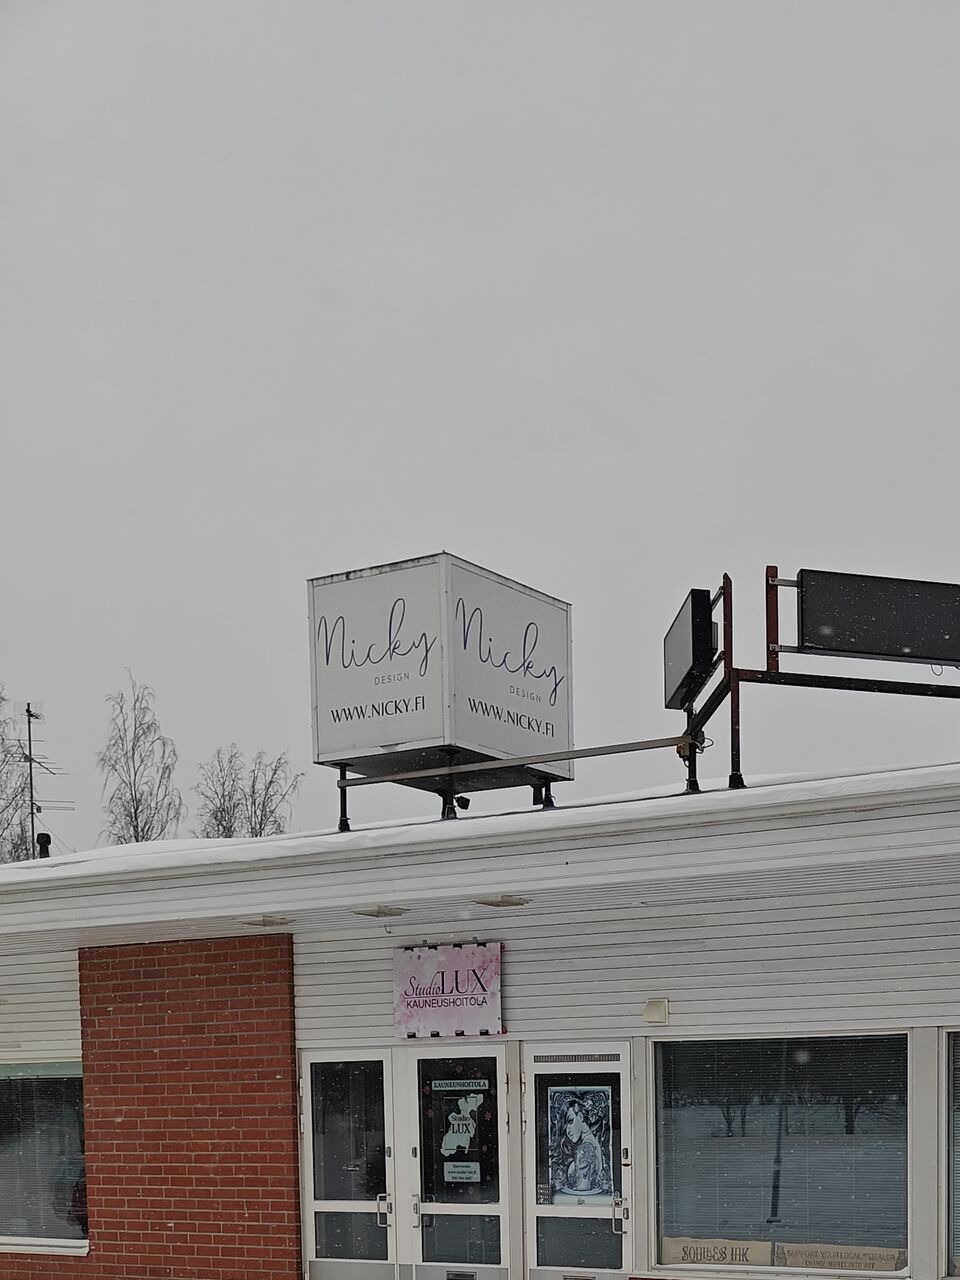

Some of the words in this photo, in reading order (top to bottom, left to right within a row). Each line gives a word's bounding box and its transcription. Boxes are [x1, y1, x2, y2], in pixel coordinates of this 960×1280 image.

[317, 598, 437, 677] Nicky
[455, 597, 565, 706] Nicky
[374, 672, 410, 685] DESIGN
[509, 685, 542, 703] DESIGN
[331, 696, 425, 723] WWW.NICKY.FI
[468, 697, 555, 737] WWW.NICKY.FI
[406, 997, 488, 1009] KAUNEUSHOITOLA
[451, 1123, 471, 1134] LUX
[731, 1247, 750, 1262] INK
